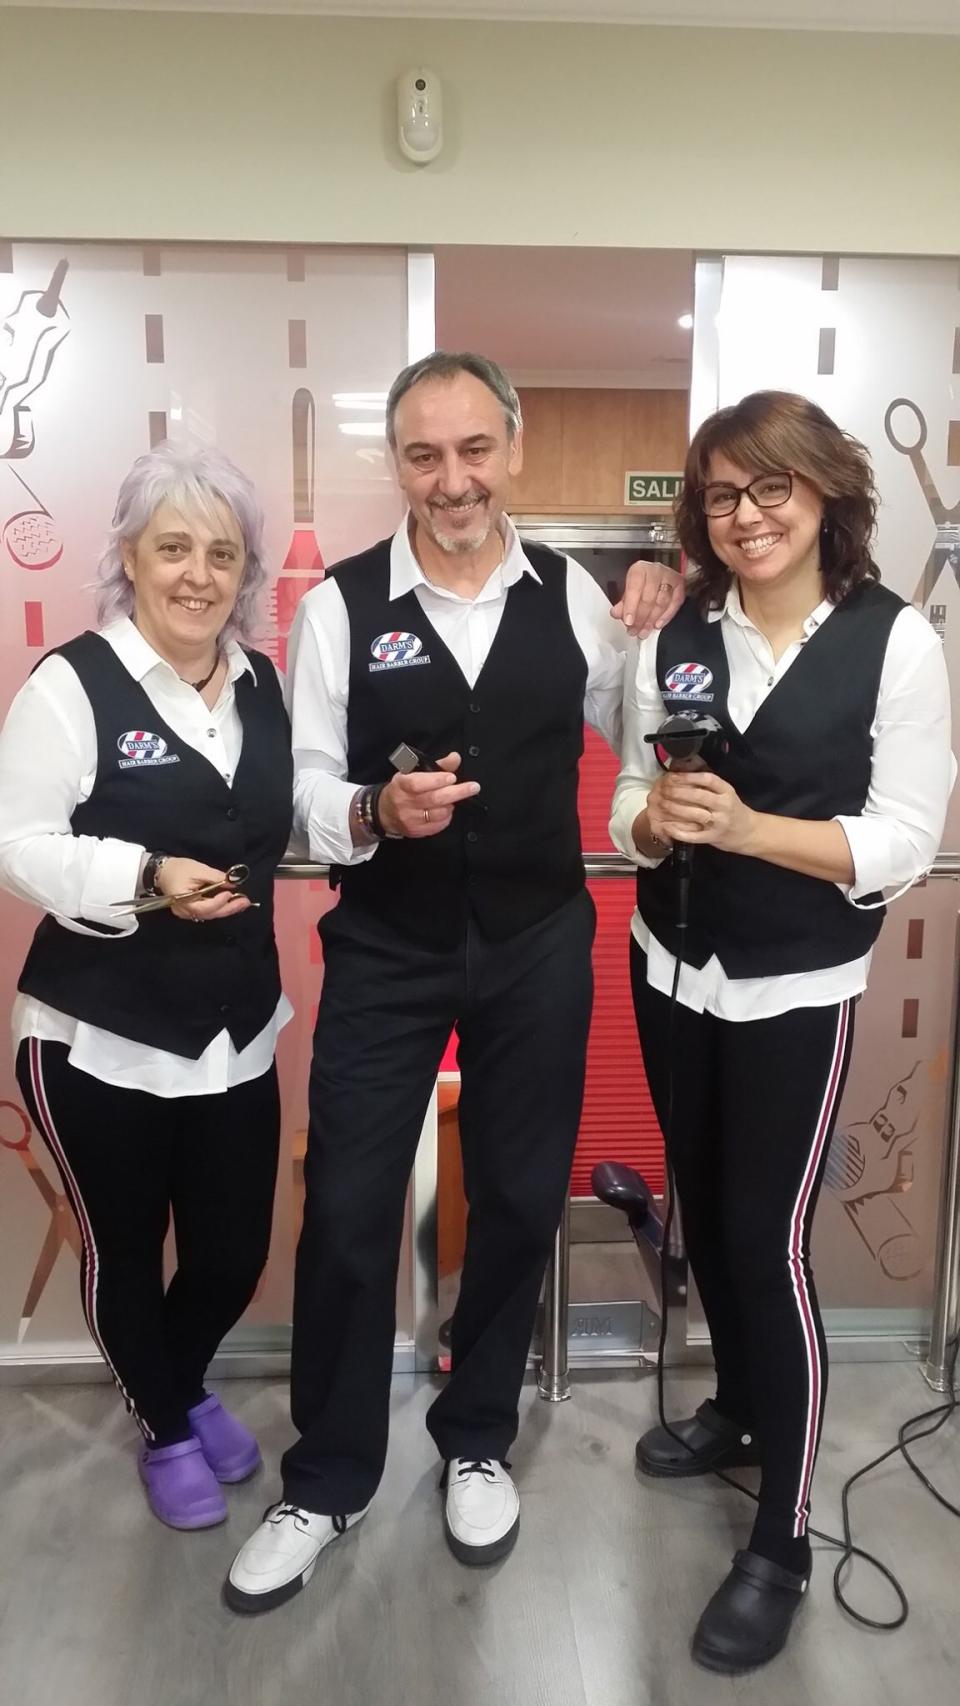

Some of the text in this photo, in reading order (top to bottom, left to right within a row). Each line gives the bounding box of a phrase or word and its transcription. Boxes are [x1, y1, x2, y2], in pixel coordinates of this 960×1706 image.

[381, 641, 412, 652] DARM'S
[371, 656, 428, 670] HAIR BARBER GROUP
[674, 673, 704, 683] DARM'S
[127, 741, 159, 750] DARM'S
[136, 758, 157, 766] BARBER
[157, 755, 177, 764] GROUP
